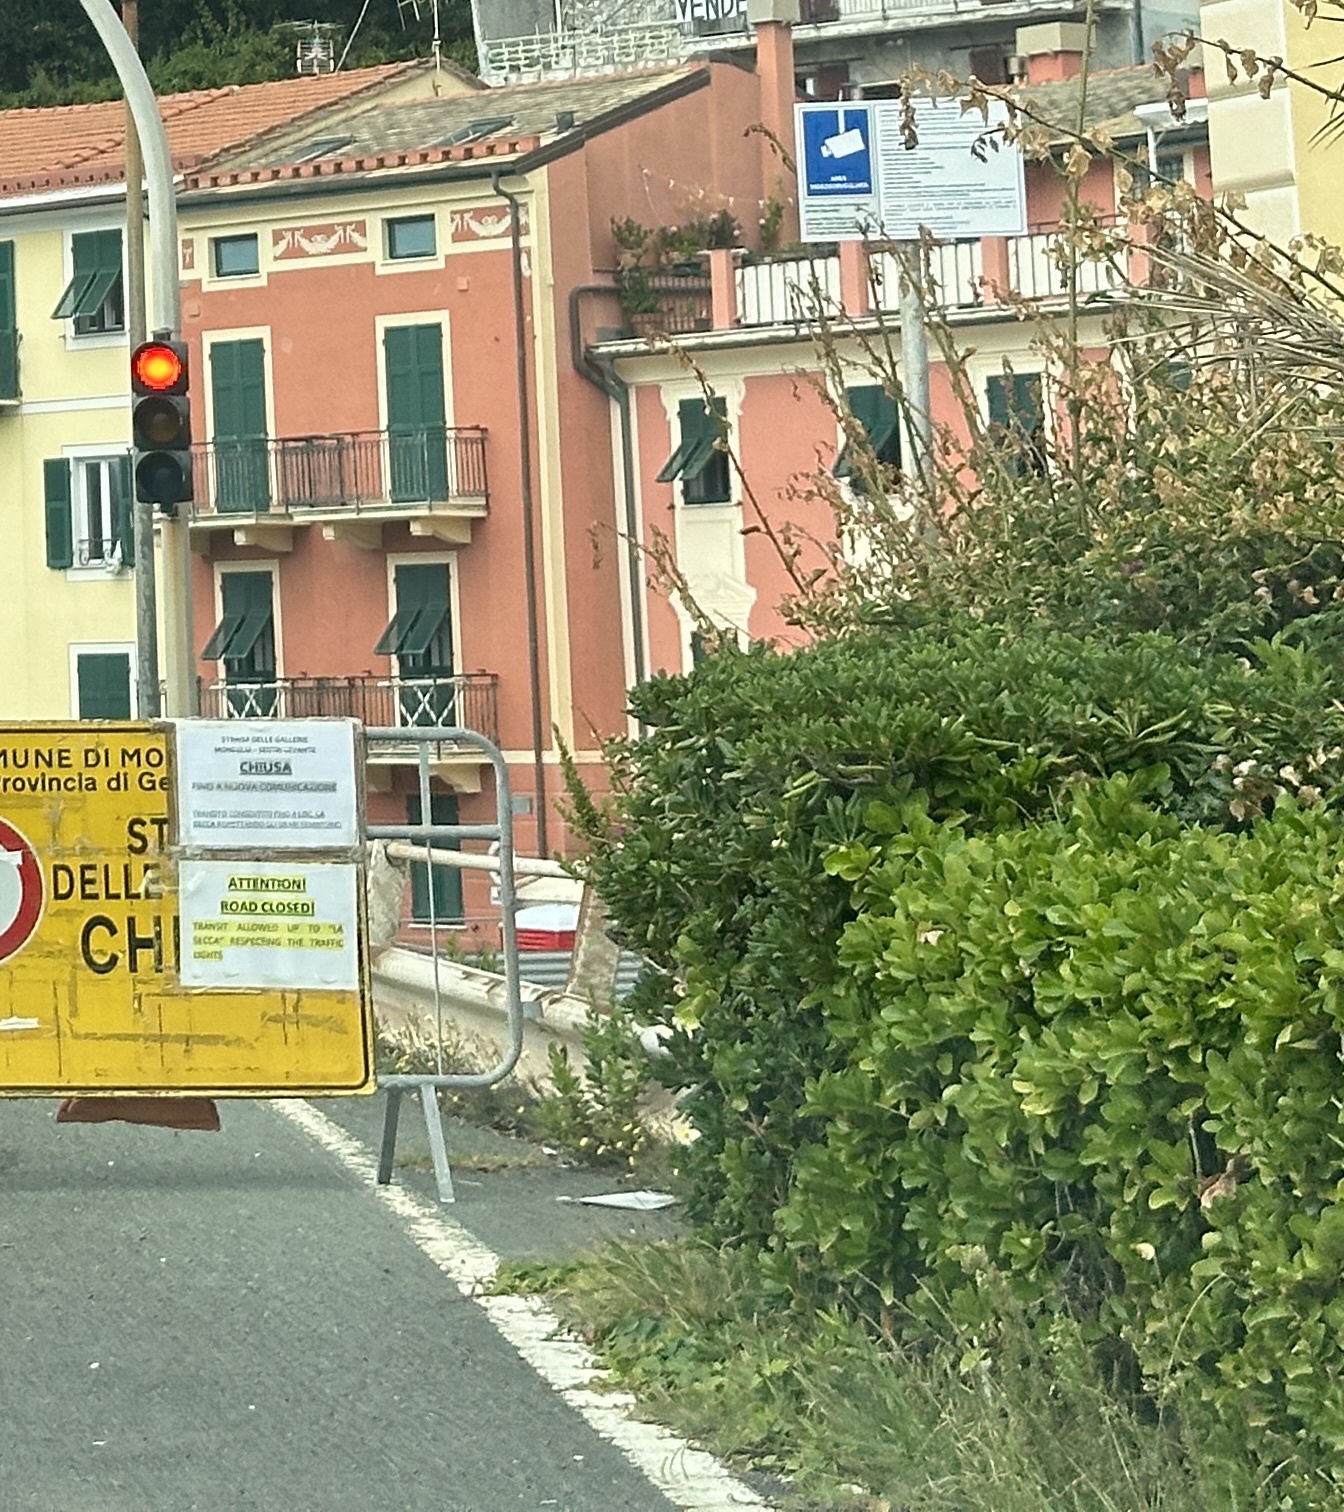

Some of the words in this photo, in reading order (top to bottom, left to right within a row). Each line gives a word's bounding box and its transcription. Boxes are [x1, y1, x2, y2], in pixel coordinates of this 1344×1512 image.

[83, 747, 110, 769] DI
[239, 761, 292, 774] CHIUSA
[106, 772, 129, 791] di
[223, 782, 257, 791] NUOVA
[126, 817, 169, 855] ST
[52, 863, 163, 900] DELLE
[228, 877, 306, 890] ATTENTION!
[221, 901, 258, 913] ROAD
[262, 901, 314, 914] CLOSED!
[193, 922, 229, 931] TRANSIT
[237, 922, 278, 932] ALLOWED
[287, 923, 299, 932] UP
[309, 923, 320, 933] TO
[287, 938, 303, 947] THE
[310, 938, 344, 948] TRAFFIC
